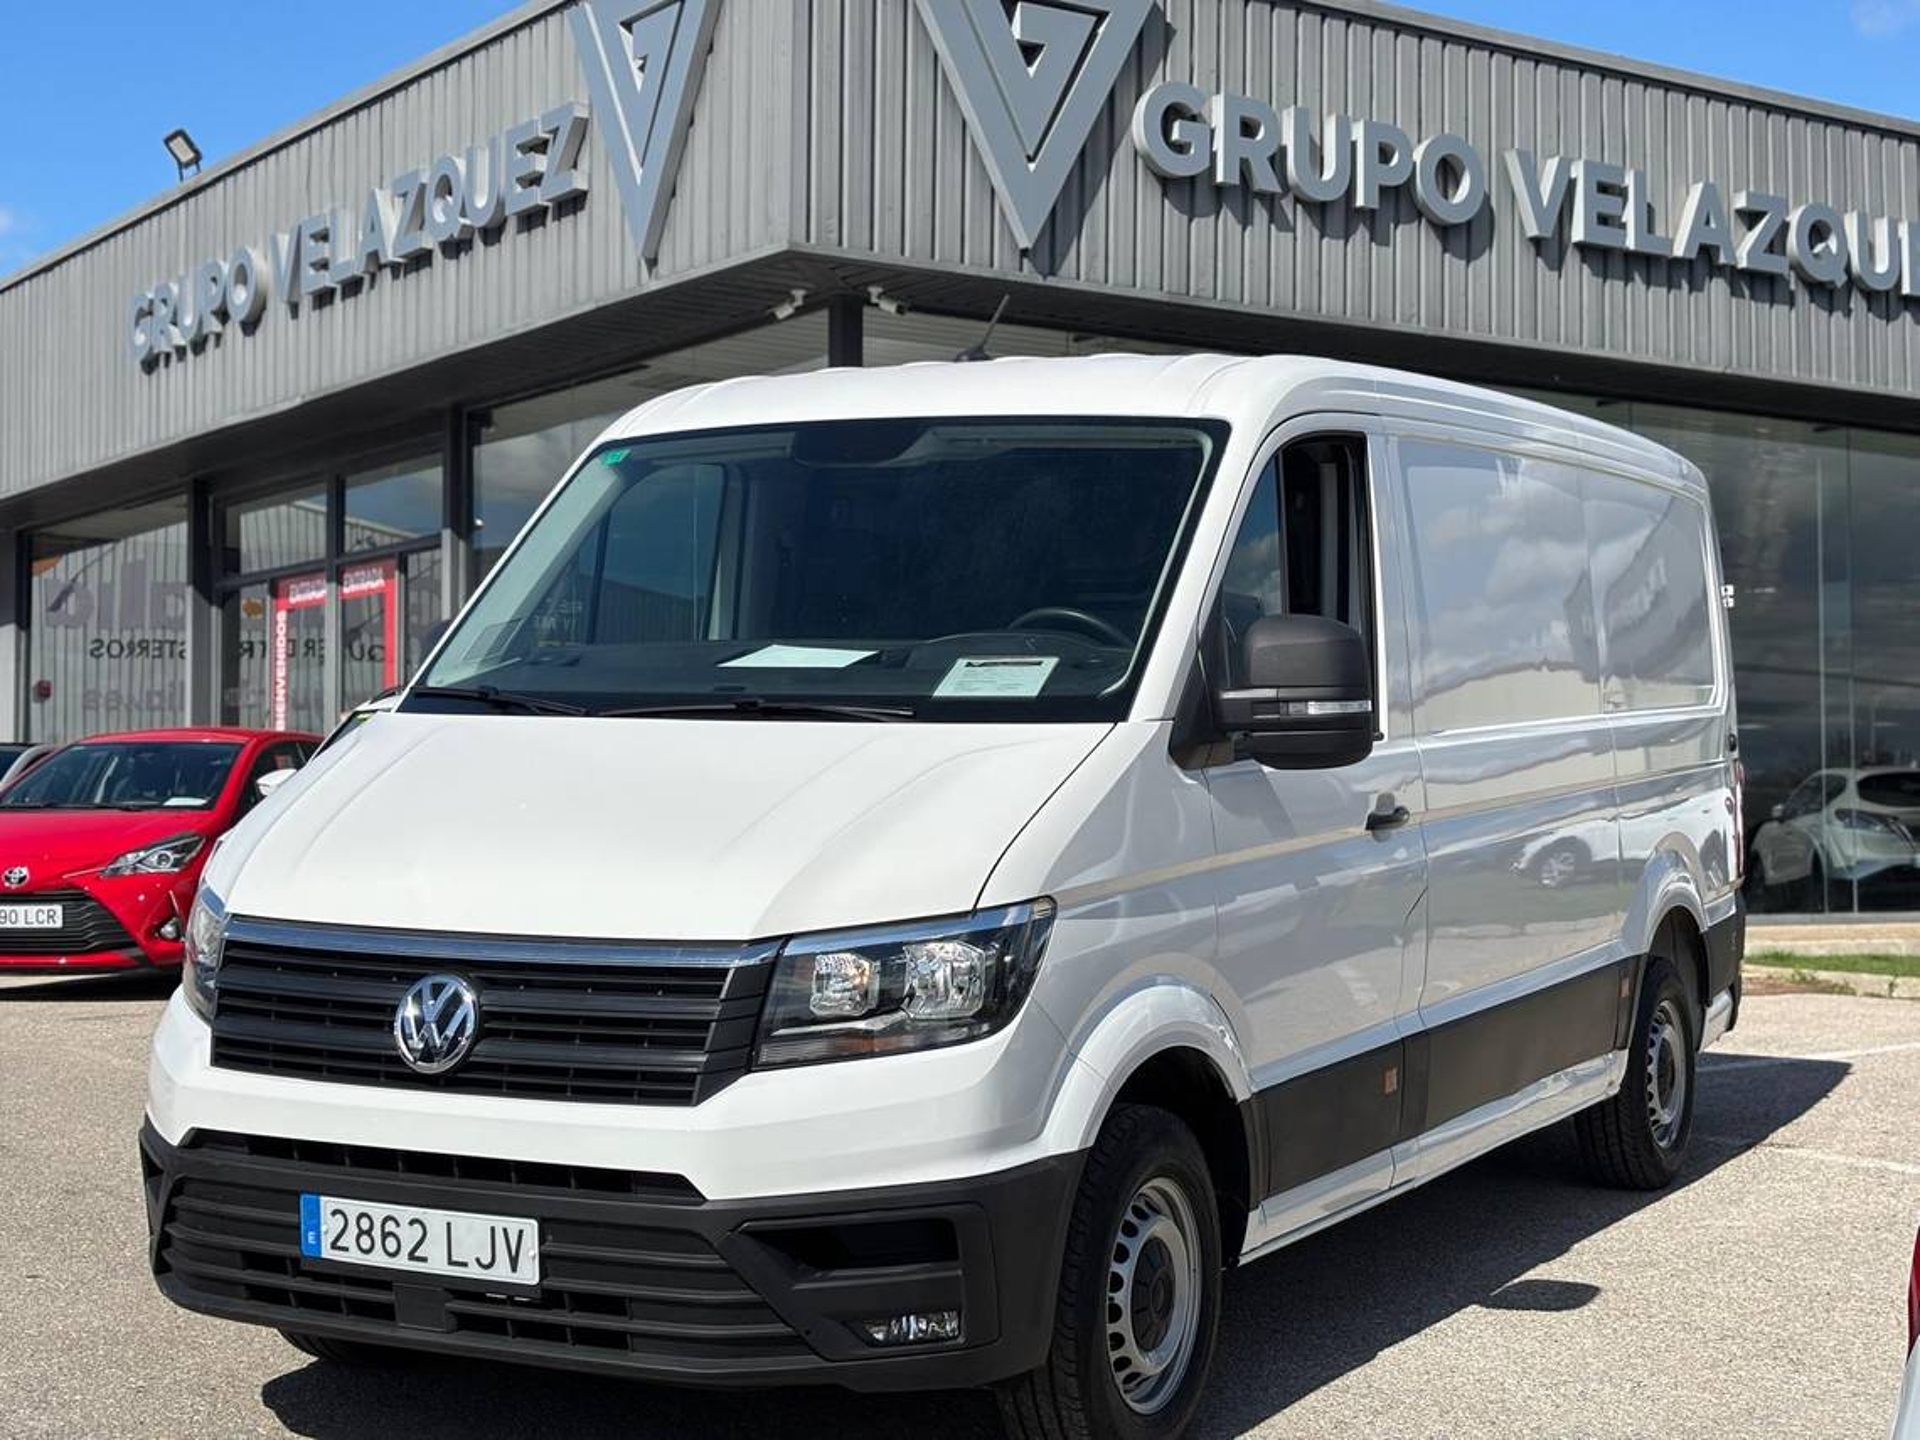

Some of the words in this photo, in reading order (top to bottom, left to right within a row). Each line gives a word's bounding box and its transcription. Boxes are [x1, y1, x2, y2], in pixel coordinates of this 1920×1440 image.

[1132, 81, 1485, 225] GRUPO
[128, 244, 266, 364] GRUPO
[270, 101, 588, 308] VELAZQUEZ
[24, 908, 57, 925] LCR
[330, 1208, 428, 1263] 2862
[446, 1221, 524, 1273] LJV
